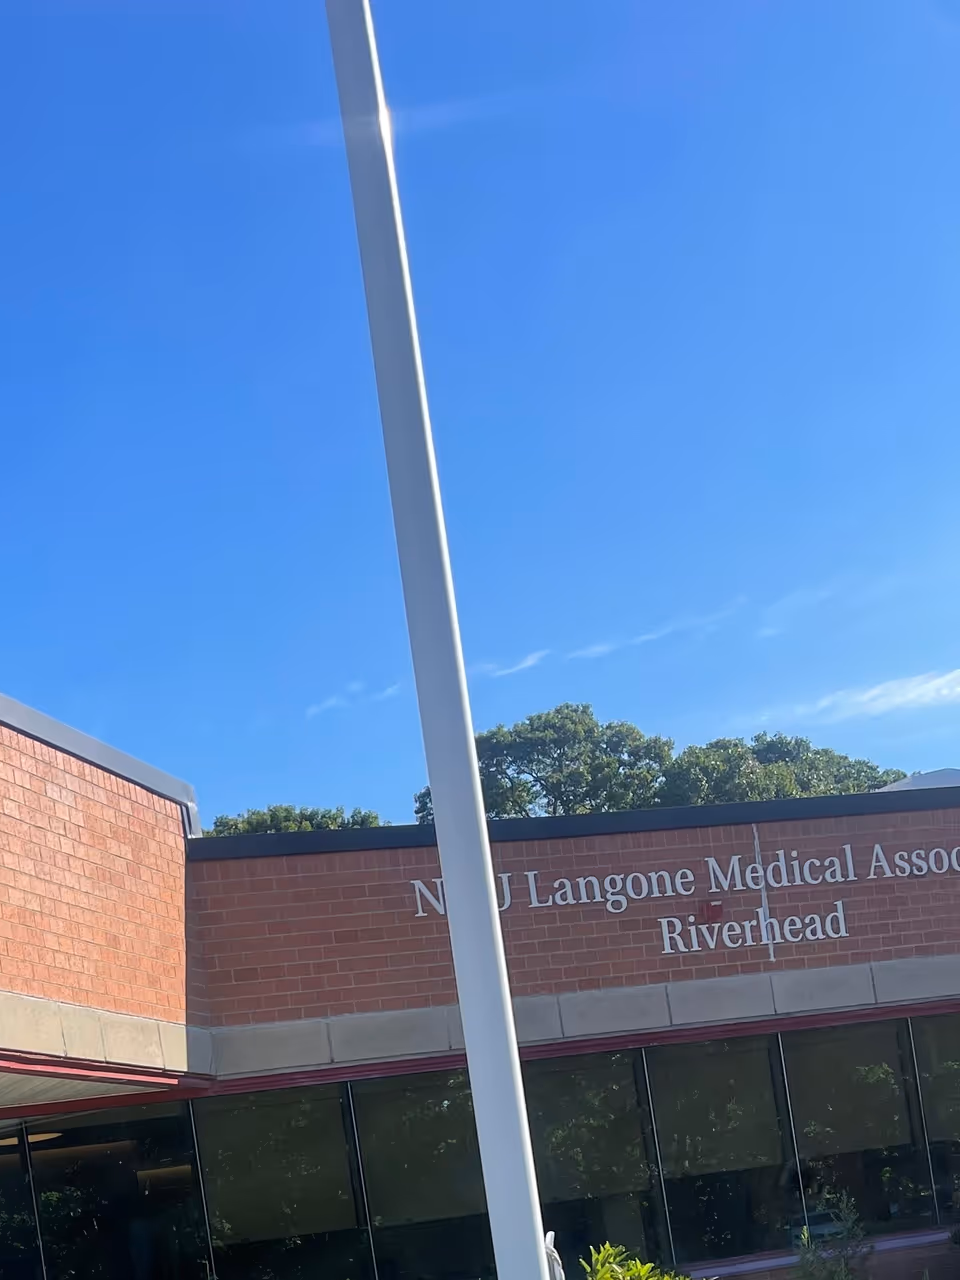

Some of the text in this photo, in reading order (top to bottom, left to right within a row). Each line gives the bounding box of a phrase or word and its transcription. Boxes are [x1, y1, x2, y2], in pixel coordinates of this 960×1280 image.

[524, 865, 696, 913] Langone
[705, 844, 858, 895] Medical
[657, 901, 850, 955] Riverhead
